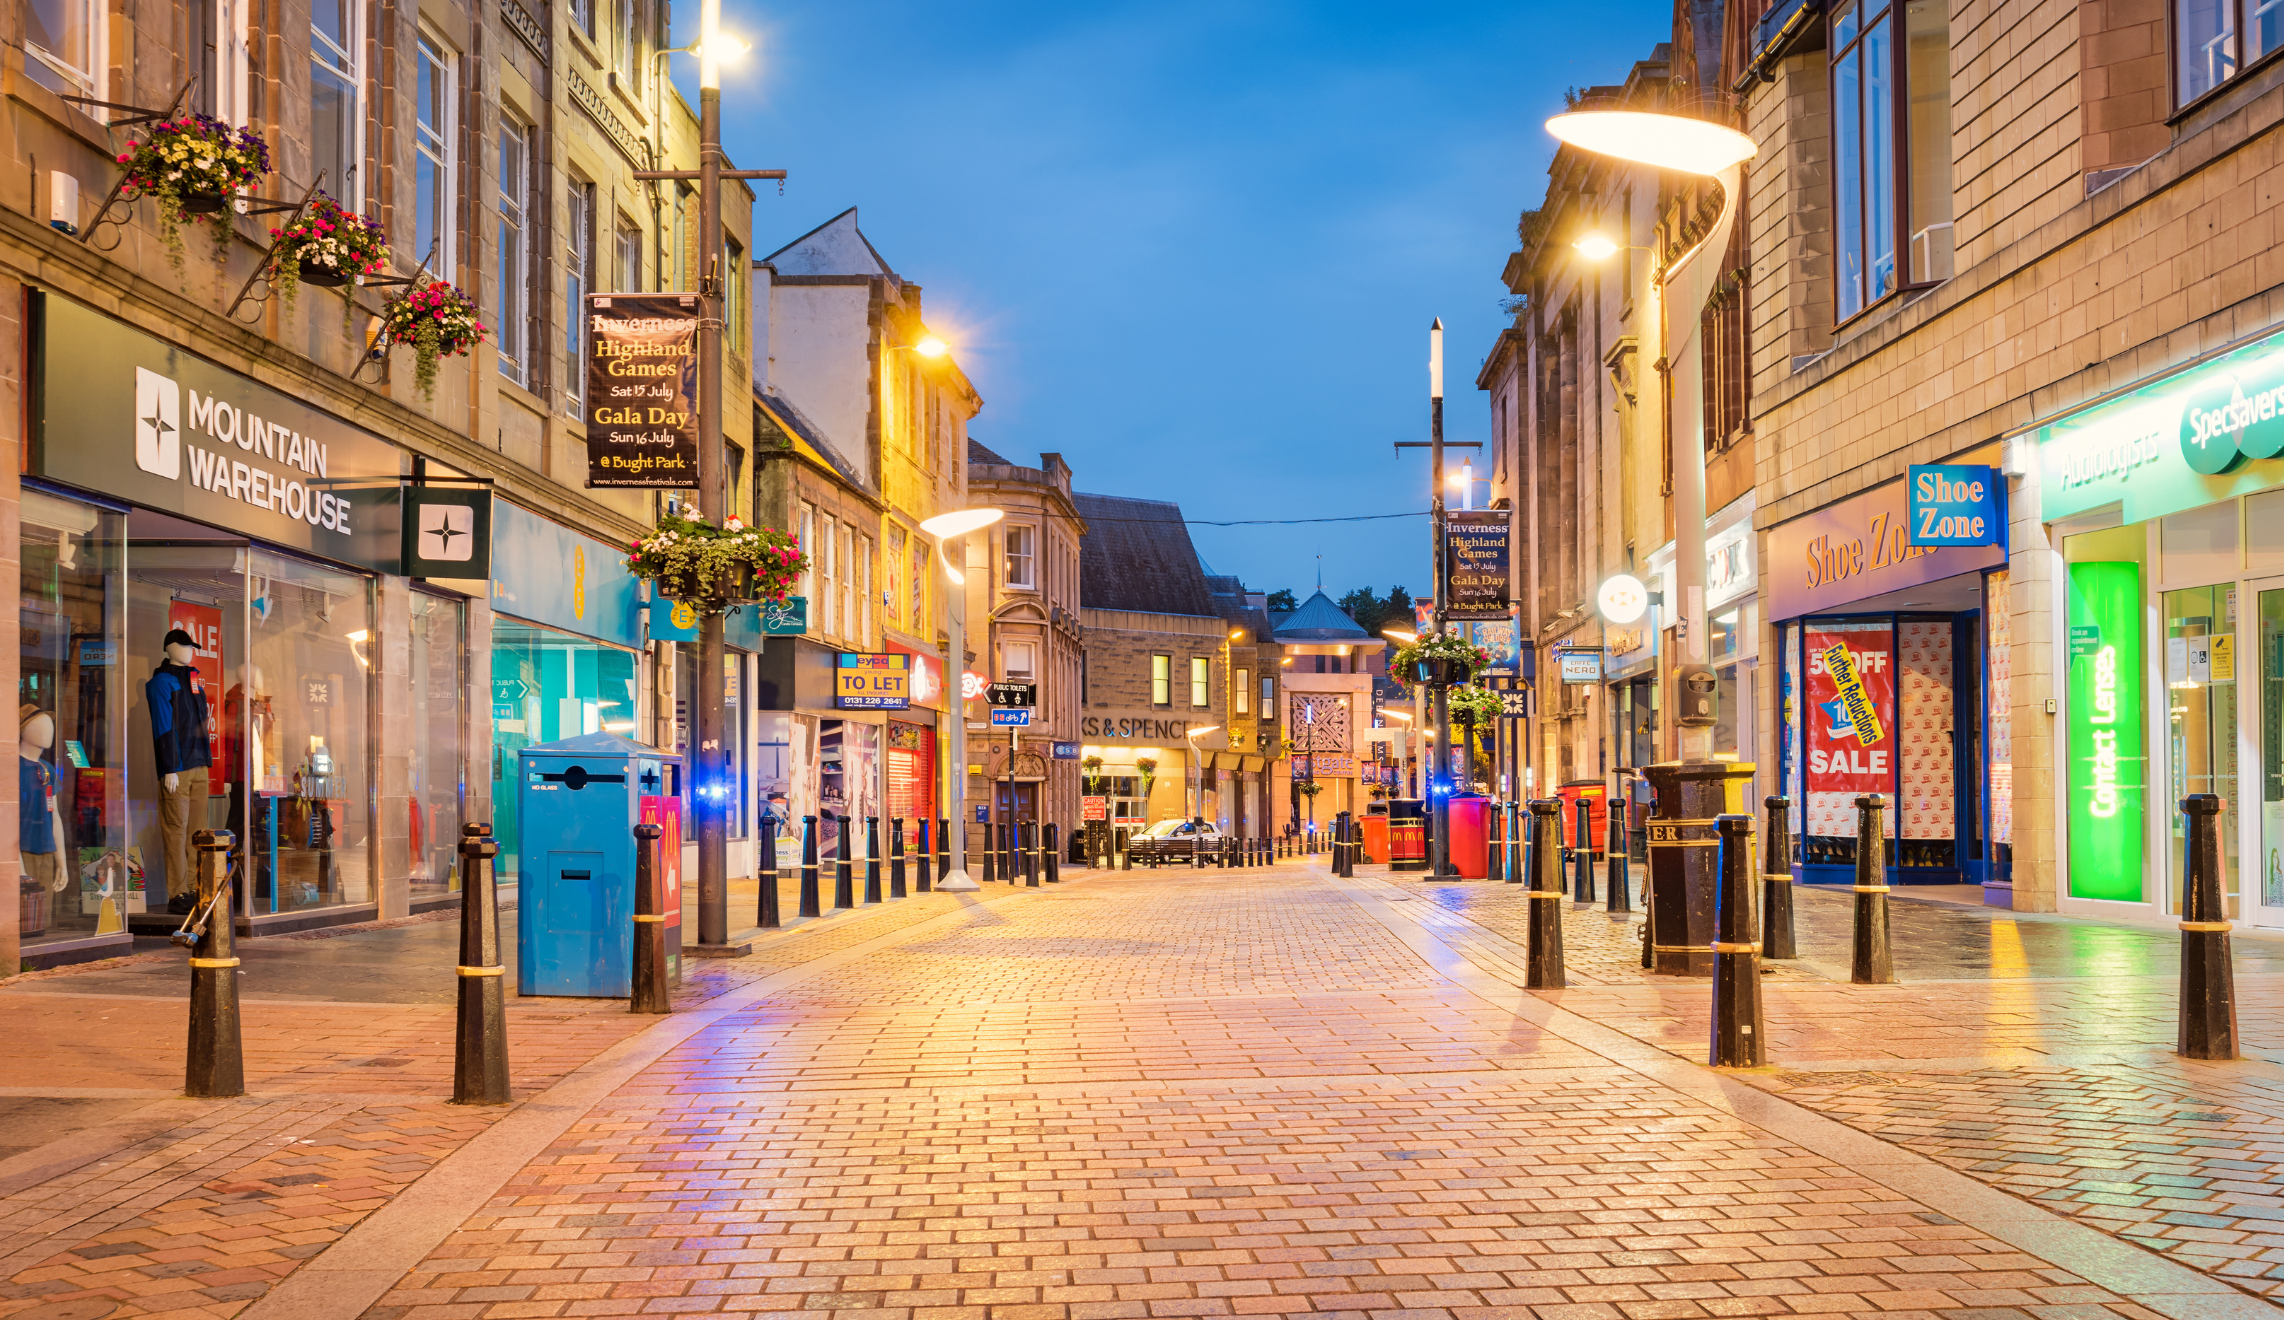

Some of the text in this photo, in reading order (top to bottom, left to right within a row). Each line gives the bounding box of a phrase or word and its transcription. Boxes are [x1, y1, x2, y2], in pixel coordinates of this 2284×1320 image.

[593, 315, 696, 332] Inverness
[596, 340, 690, 361] Highland
[608, 360, 677, 377] Games
[610, 383, 674, 401] Sat 15 July
[595, 407, 690, 429] Gala Day
[188, 389, 327, 479] MOUNTAIN
[609, 428, 675, 448] Sun 16 July
[600, 453, 686, 473] @ Bught Park
[2061, 432, 2160, 491] Audiologists
[187, 444, 352, 535] WAREHOUSE
[1917, 472, 1984, 503] Shoe
[1447, 522, 1508, 533] Inverness
[1918, 507, 1985, 539] Zone
[1450, 537, 1506, 550] Highland
[1806, 533, 1864, 589] Shoe
[1868, 511, 1940, 572] Zo
[1458, 548, 1498, 559] Games
[1473, 562, 1480, 570] 15
[1480, 561, 1496, 572] July
[1450, 575, 1506, 588] Gala Day
[1459, 587, 1497, 598] Sun 16 July
[1460, 600, 1484, 613] Bught
[1485, 600, 1503, 610] Park
[1482, 626, 1512, 637] RAILWAY
[2071, 636, 2098, 646] appointment
[1565, 666, 1596, 674] NERO
[842, 675, 903, 691] TO LET
[993, 683, 1027, 692] PUBLIC TOILETS
[1825, 643, 1878, 745] Further Reductions
[1103, 717, 1116, 737] &
[2090, 645, 2117, 818] Contact Lenses
[1057, 746, 1078, 754] TSB
[1809, 749, 1888, 775] SALE
